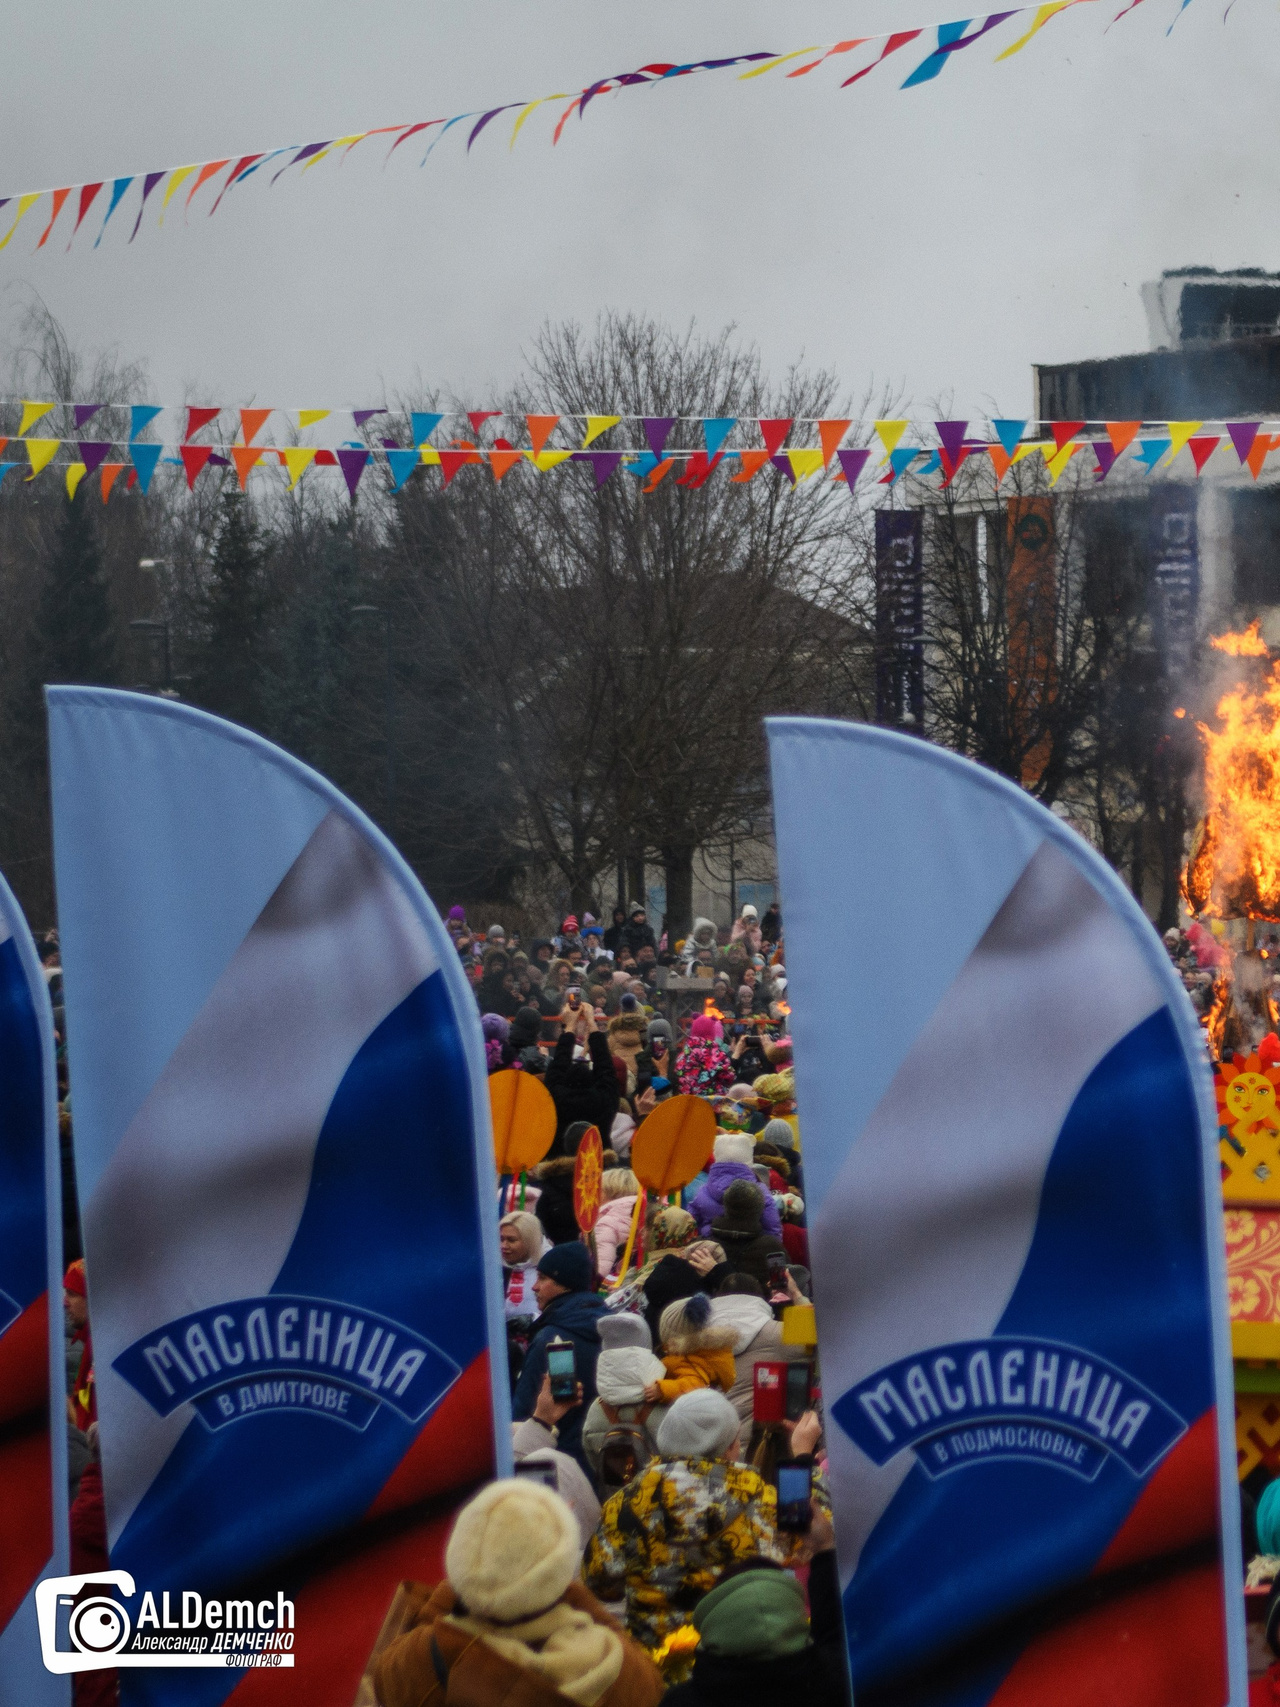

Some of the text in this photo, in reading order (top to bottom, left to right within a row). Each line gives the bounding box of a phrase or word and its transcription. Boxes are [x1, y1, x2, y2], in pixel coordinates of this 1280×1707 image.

[143, 1307, 427, 1396] МАСЛЕНИЦА
[216, 1380, 351, 1417] В ДМИТРОВЕ
[859, 1349, 1151, 1448] МАСЛЕНИЦА
[934, 1425, 1088, 1464] В ПОДМОСКОВЬЕ
